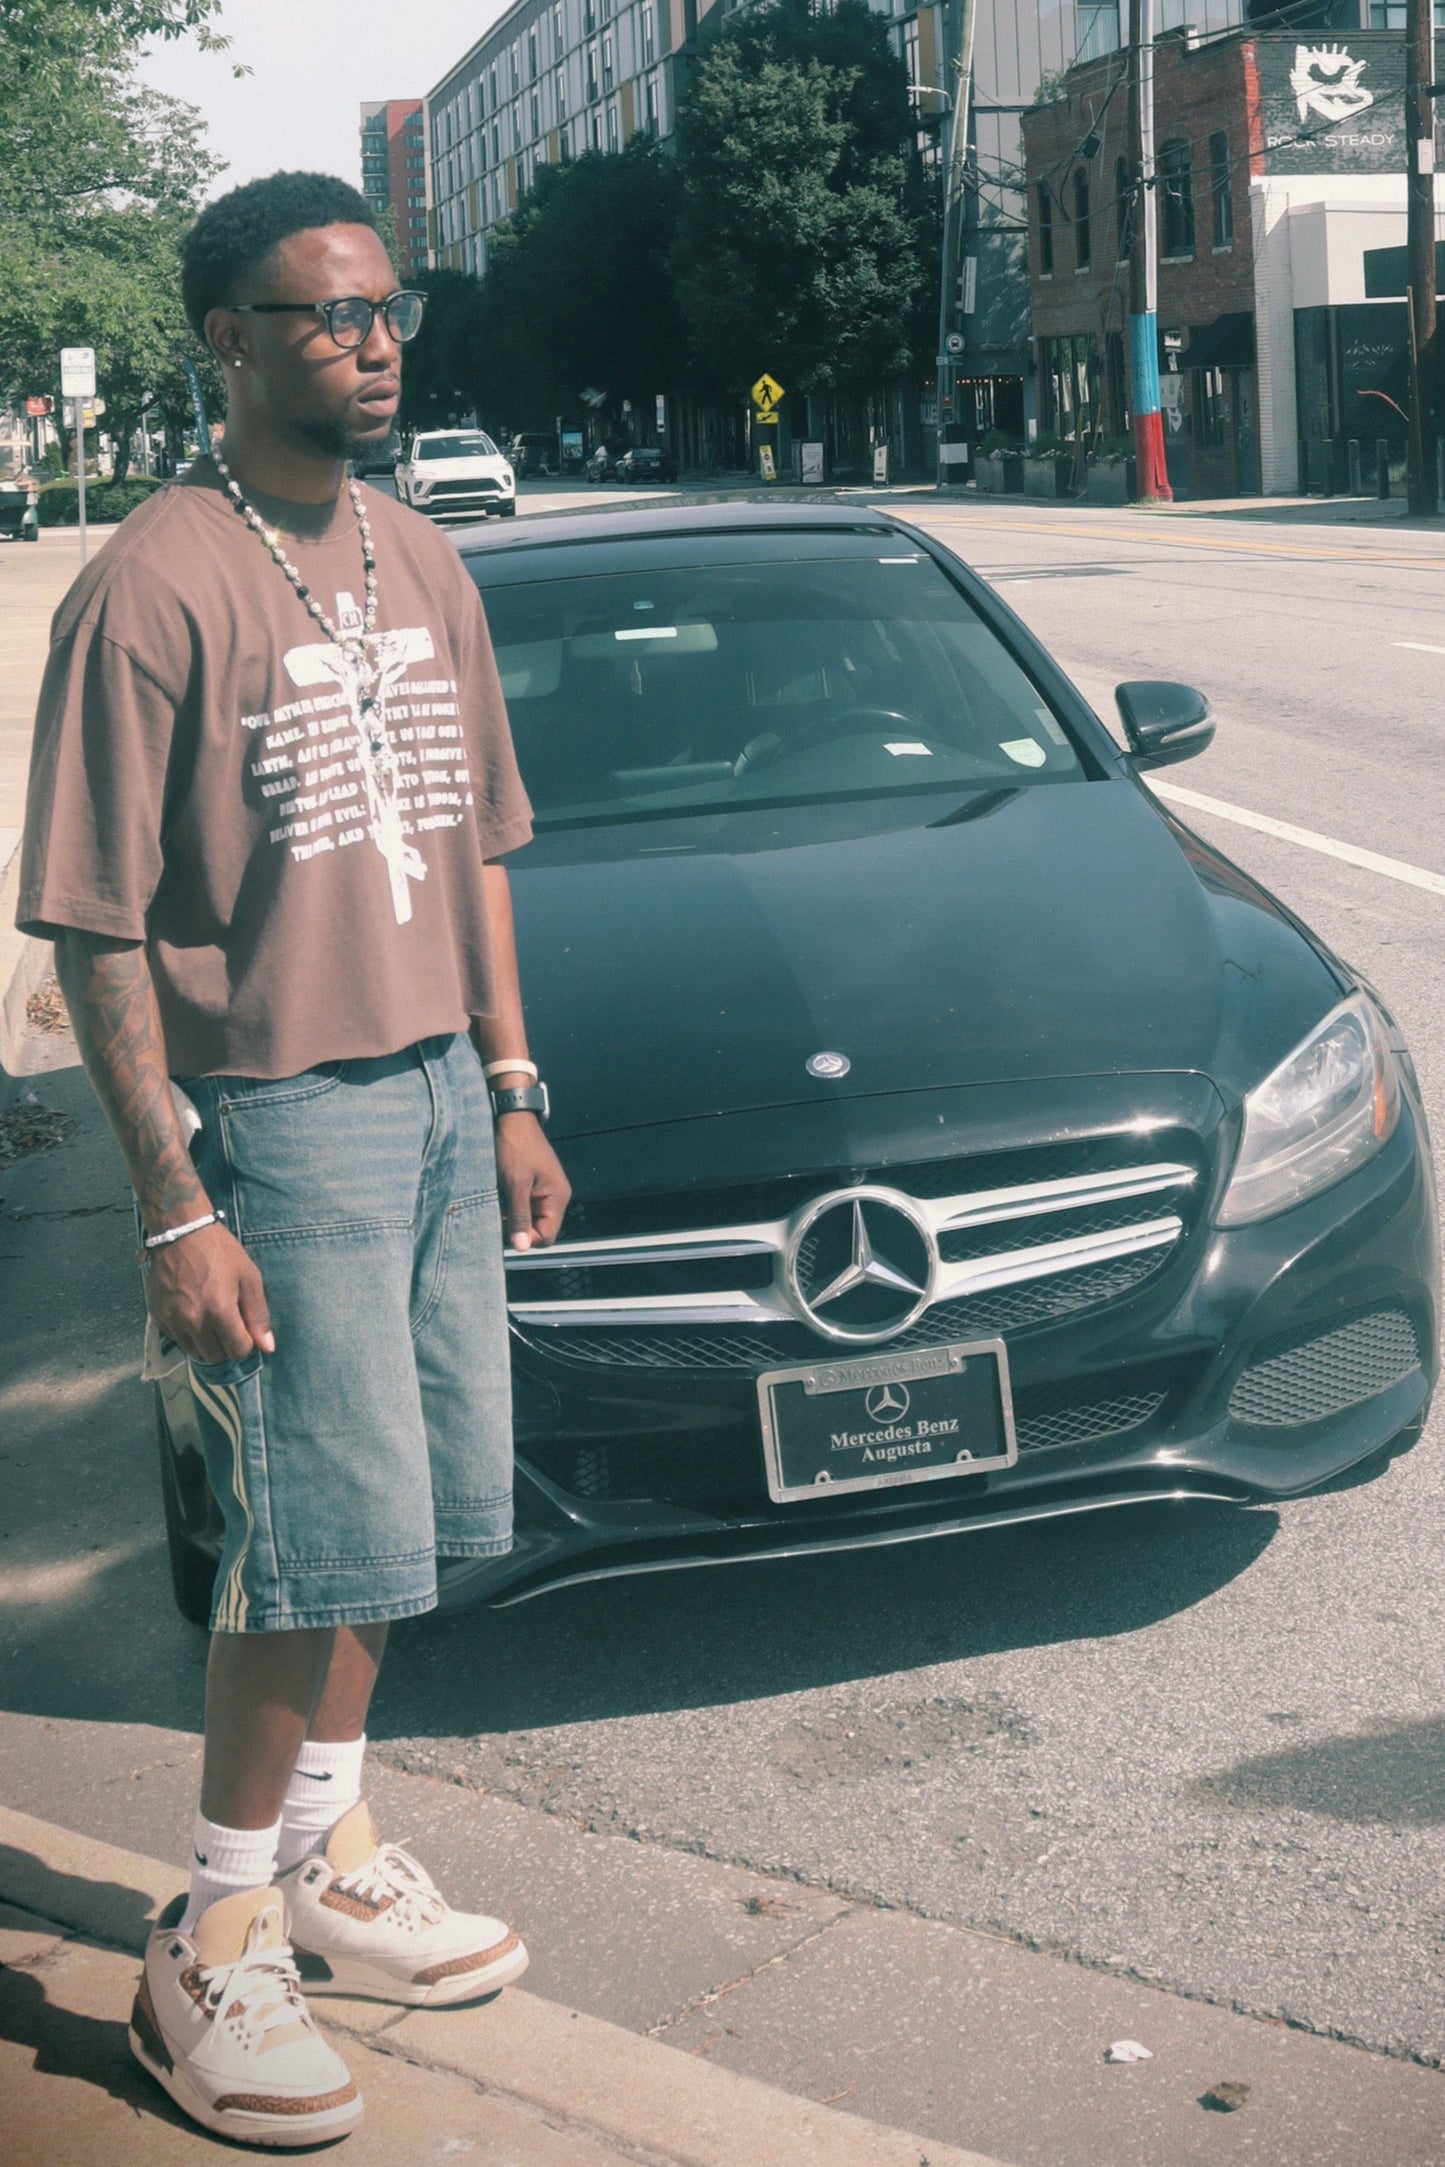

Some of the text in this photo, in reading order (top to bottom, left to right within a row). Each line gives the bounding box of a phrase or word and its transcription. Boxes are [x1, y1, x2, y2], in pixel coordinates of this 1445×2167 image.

[1324, 134, 1395, 147] STEADY
[830, 1418, 959, 1448] Mercedes Benz
[861, 1442, 932, 1463] Augusta
